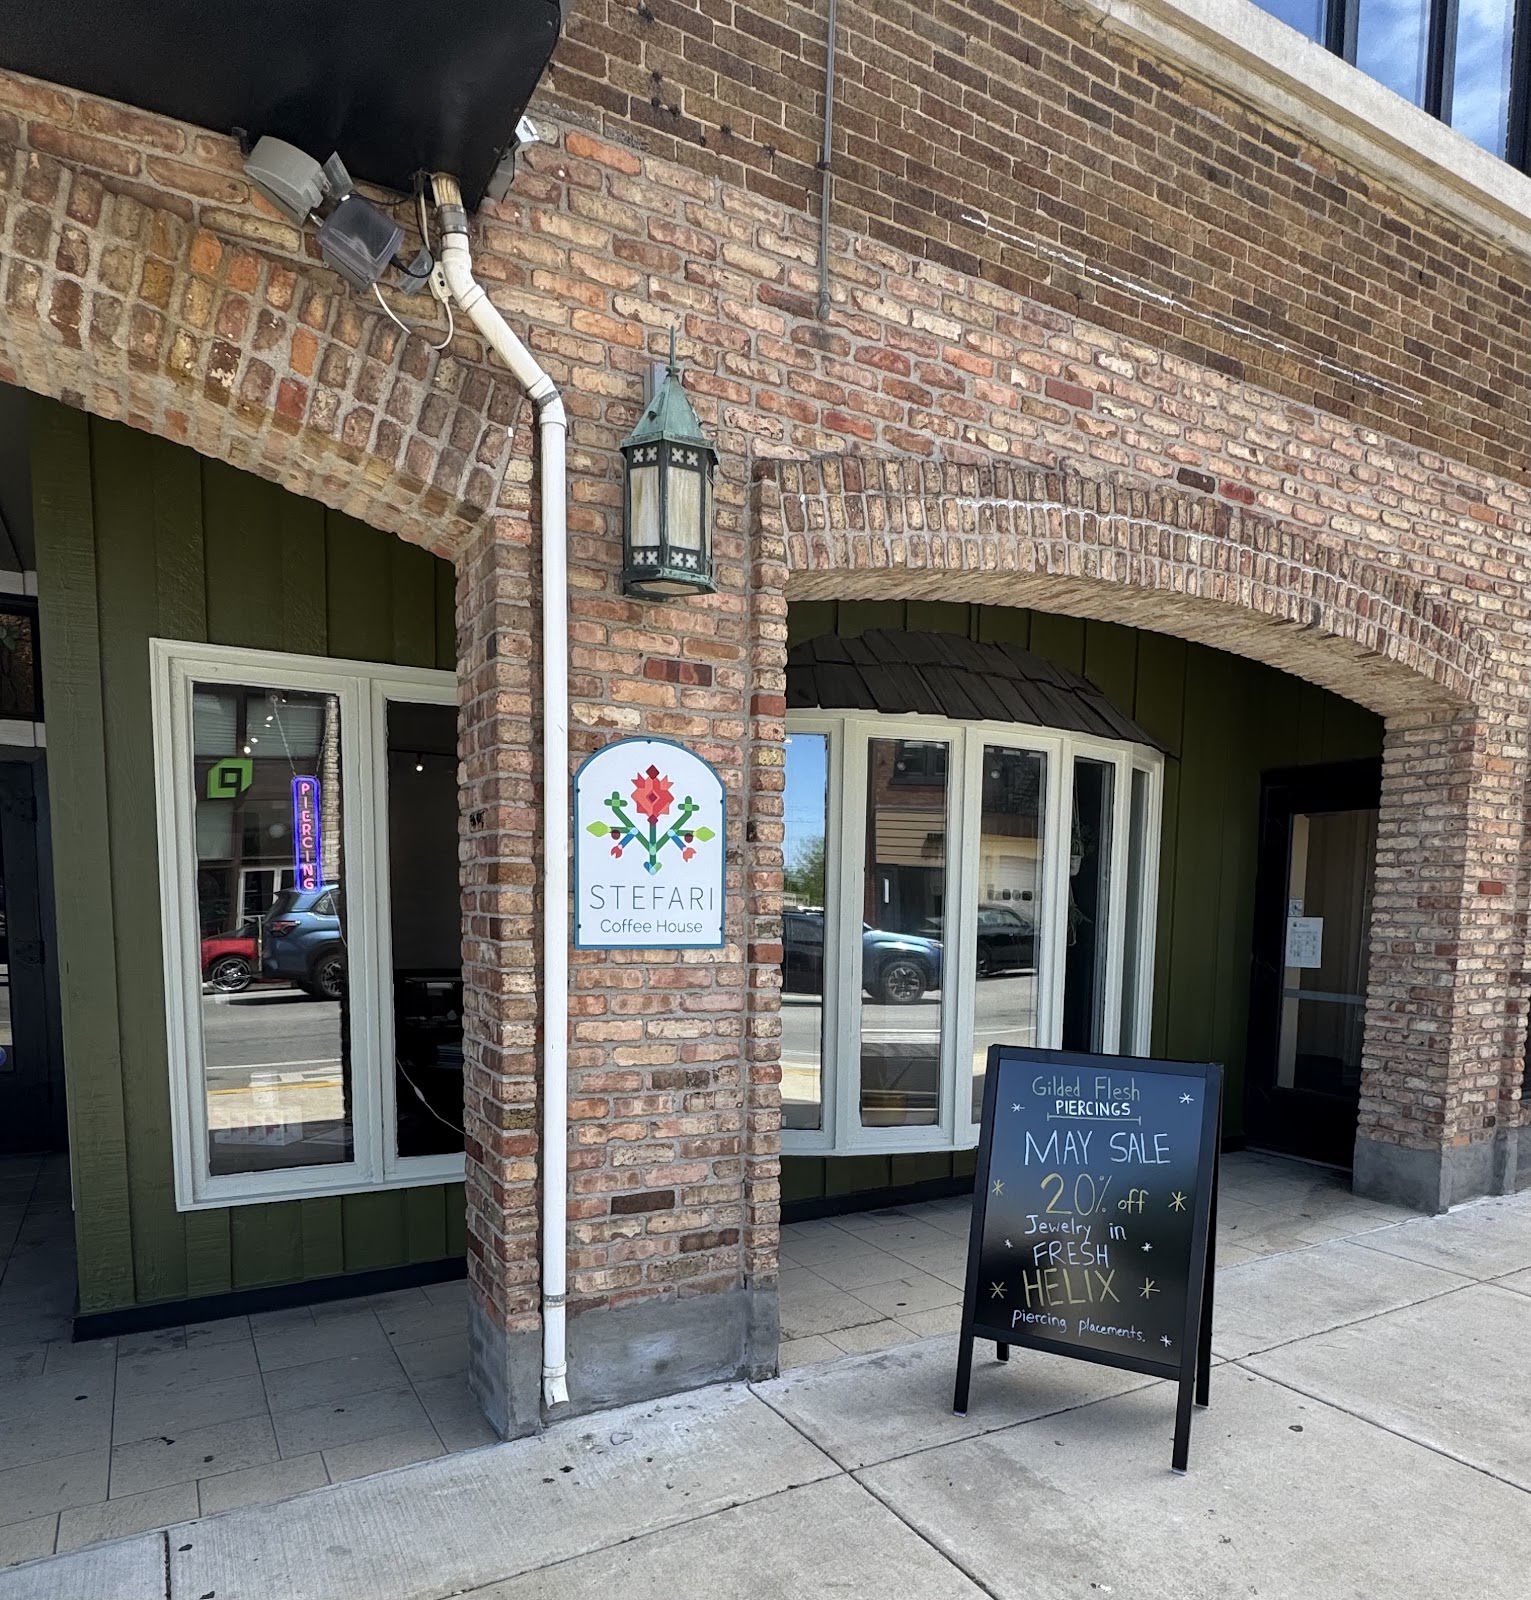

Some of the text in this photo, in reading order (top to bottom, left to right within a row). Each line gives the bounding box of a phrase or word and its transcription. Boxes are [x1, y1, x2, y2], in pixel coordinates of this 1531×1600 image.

[301, 783, 315, 890] PIERCING
[589, 884, 714, 911] STEFARI
[600, 919, 703, 934] Coffee House
[1032, 1076, 1141, 1101] Gilded Flesh
[1055, 1100, 1131, 1117] PIERCINGS
[1024, 1130, 1171, 1166] MAY SALE
[1040, 1173, 1149, 1216] 20% off
[1024, 1214, 1127, 1244] Jewelry in
[1032, 1240, 1109, 1269] FRESH
[1022, 1268, 1120, 1308] HELIX
